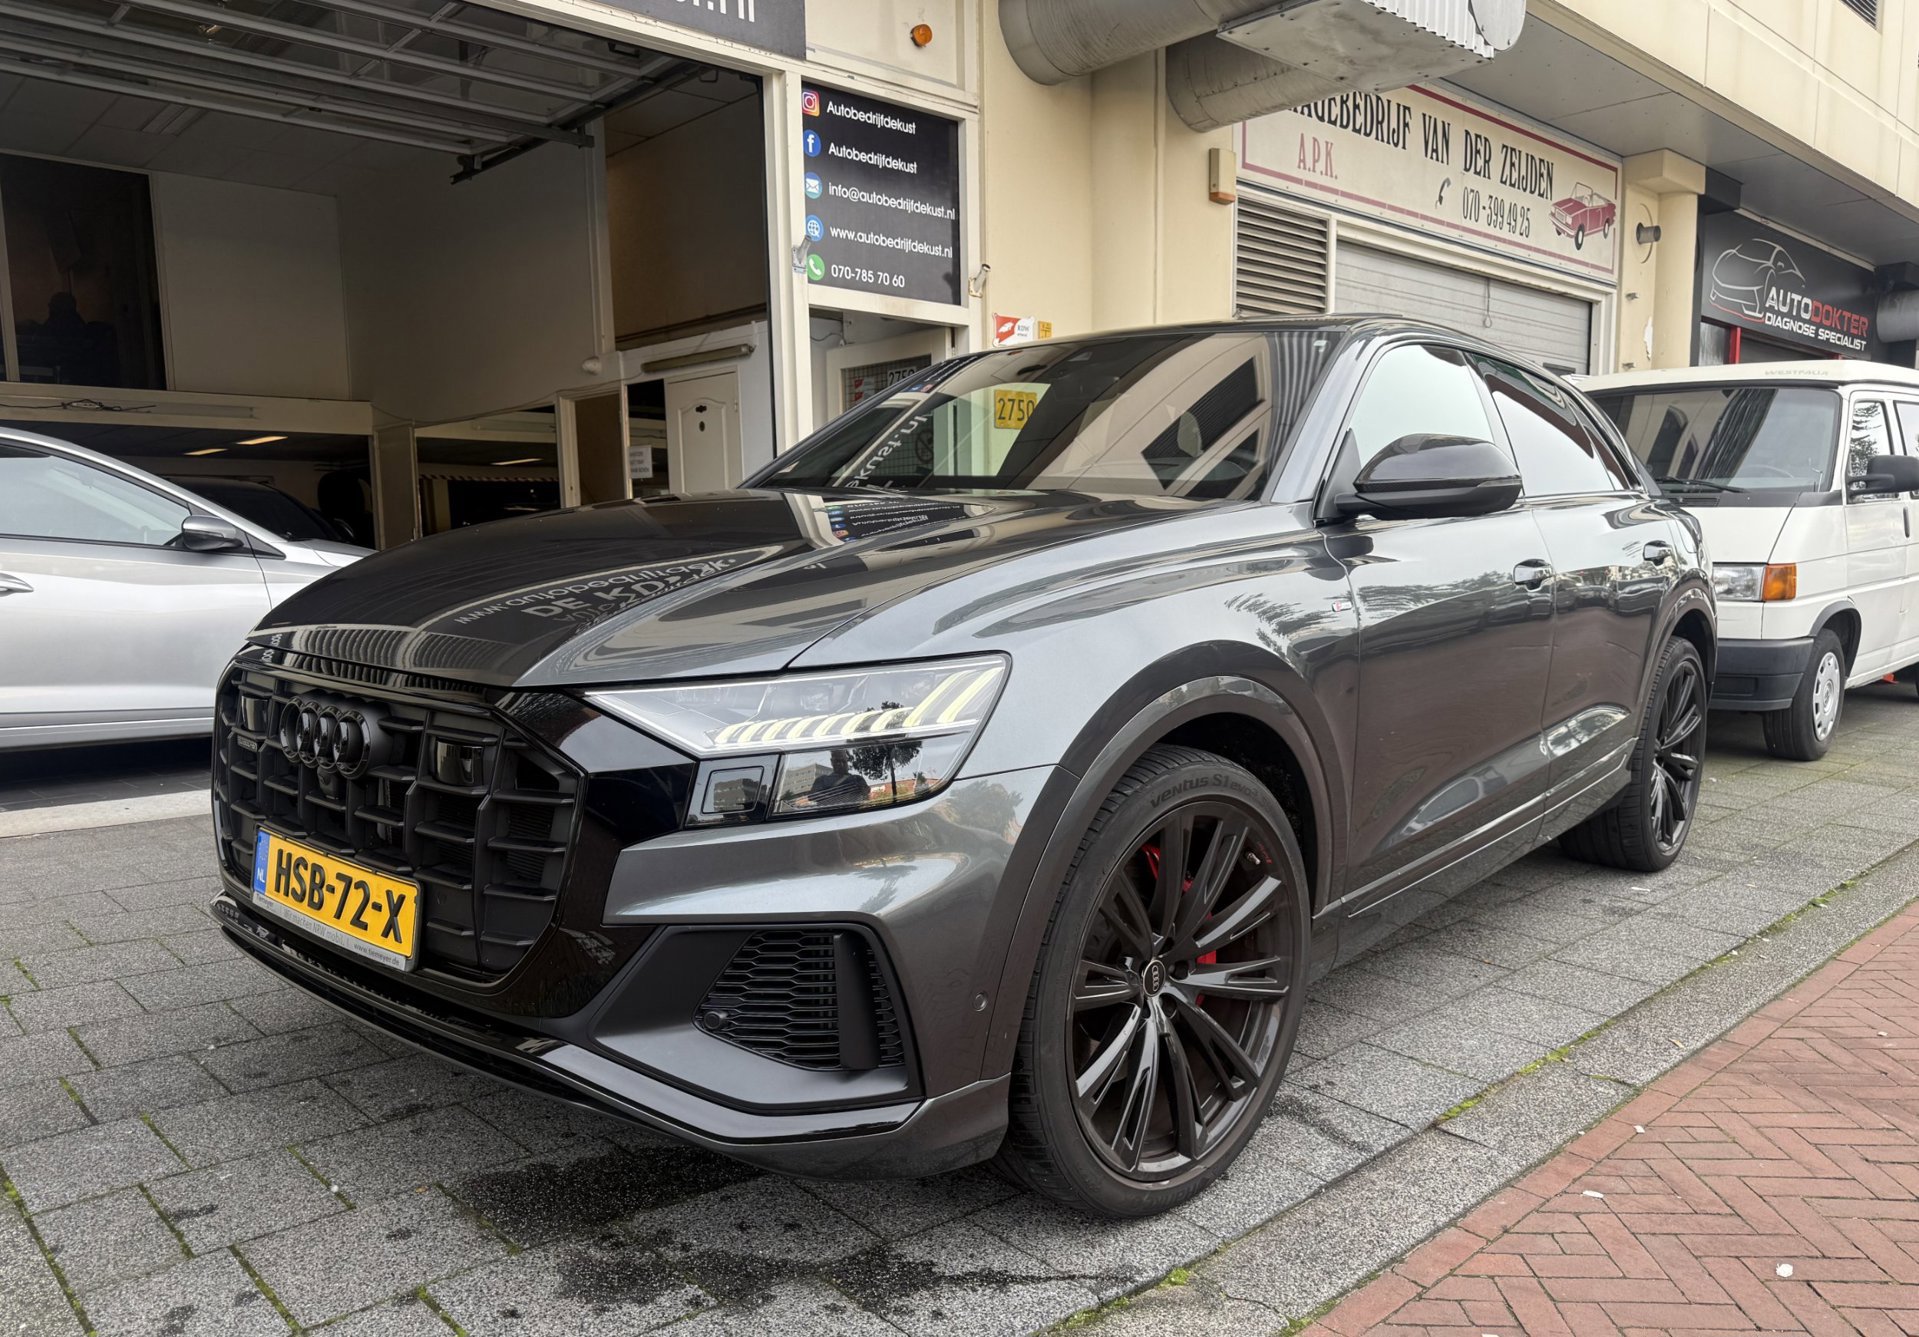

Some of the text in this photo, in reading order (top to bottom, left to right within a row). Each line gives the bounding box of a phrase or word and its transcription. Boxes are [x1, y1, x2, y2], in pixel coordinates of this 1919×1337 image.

[827, 101, 916, 135] Autobedrijfdekust
[828, 142, 918, 174] Autobedrijfdekust
[1287, 91, 1554, 200] EBEDRIJF VAN DER ZEIJDEN
[1297, 133, 1338, 180] A.P.K.
[828, 182, 956, 220] info@autobedrijfdekust.nl
[830, 226, 953, 259] www.autobedrijfdekust.nl
[831, 264, 906, 288] 070-785 70 60
[1765, 286, 1869, 337] AUTODOKTER
[1764, 313, 1867, 352] DIAGNOSE SPECIALIST
[998, 397, 1035, 421] 2750
[256, 868, 266, 884] NL
[274, 848, 406, 944] HSB-72-X
